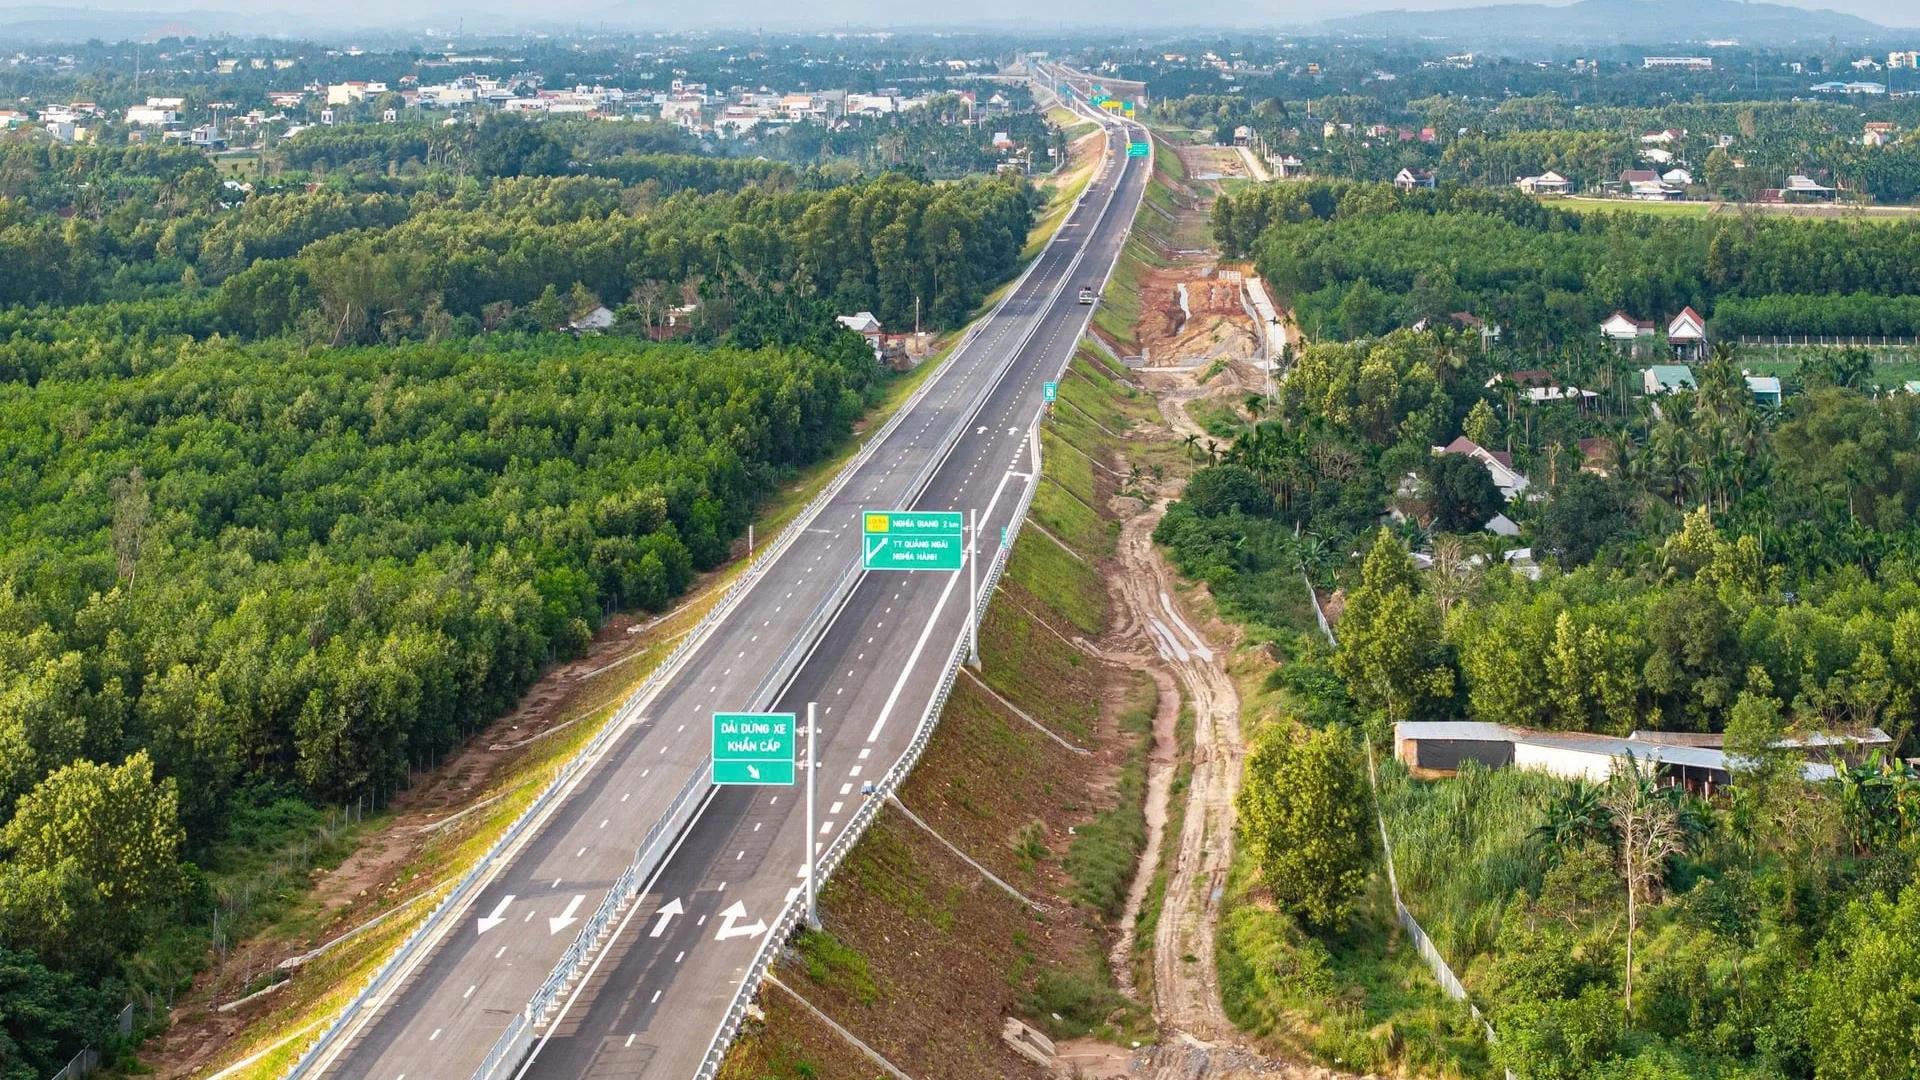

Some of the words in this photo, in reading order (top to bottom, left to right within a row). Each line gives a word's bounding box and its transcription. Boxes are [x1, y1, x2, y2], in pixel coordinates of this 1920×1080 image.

[917, 520, 939, 528] GIANG
[943, 520, 947, 528] 2
[721, 720, 737, 733] DẢI
[740, 720, 769, 734] DỪNG
[773, 724, 786, 734] XE
[728, 736, 757, 751] KHẨN
[760, 737, 781, 751] CẤP
